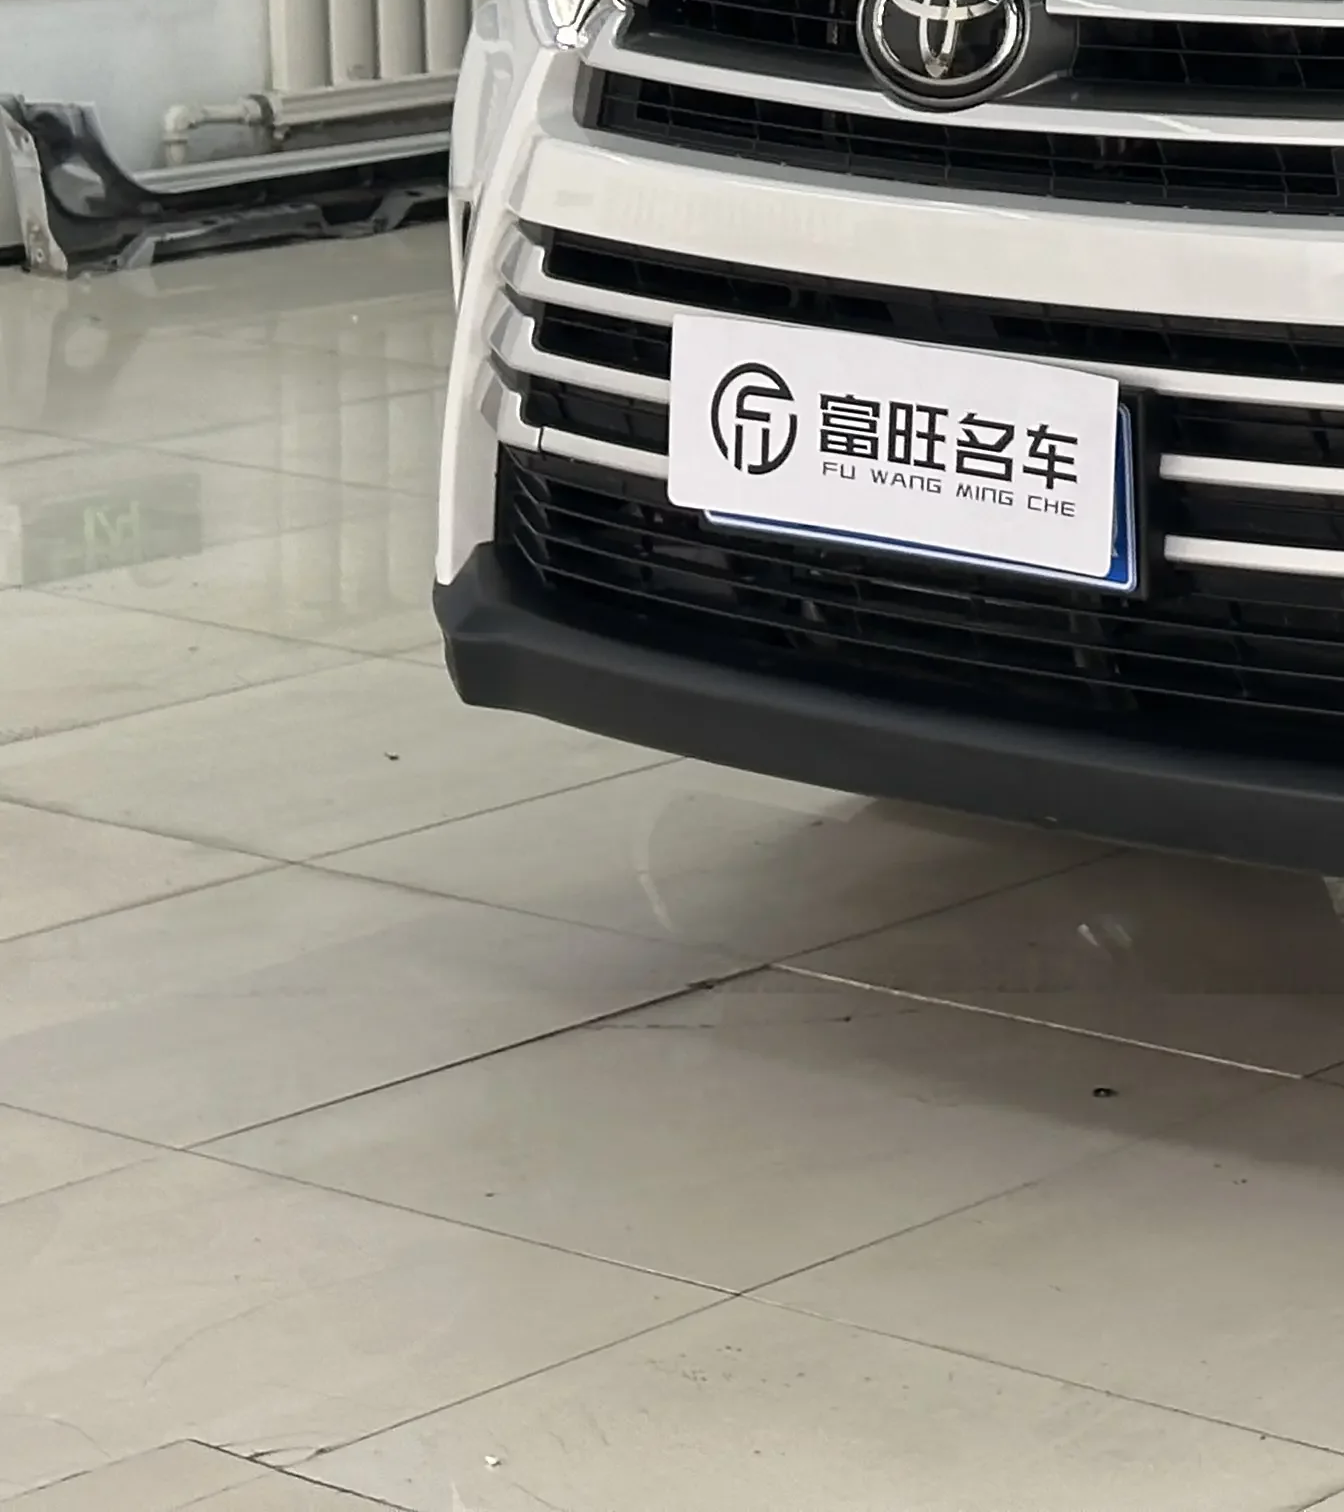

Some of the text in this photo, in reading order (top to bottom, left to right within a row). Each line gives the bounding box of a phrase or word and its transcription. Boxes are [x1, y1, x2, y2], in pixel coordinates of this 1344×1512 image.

[819, 394, 1078, 490] 富旺名车
[822, 462, 1077, 518] FU WANG MING CHE
